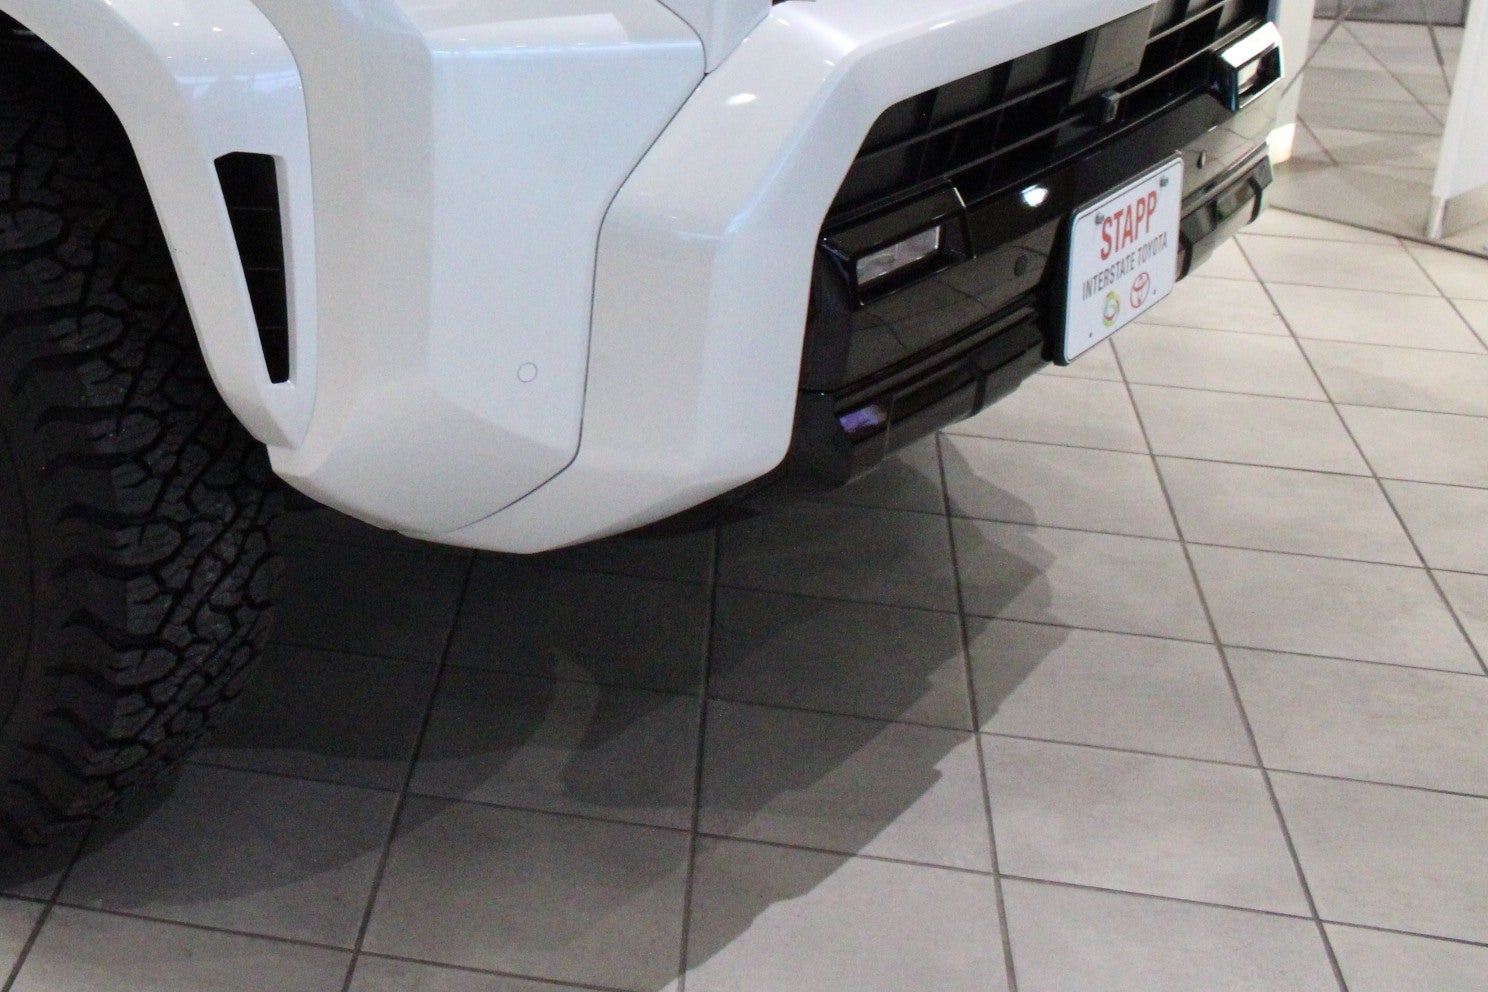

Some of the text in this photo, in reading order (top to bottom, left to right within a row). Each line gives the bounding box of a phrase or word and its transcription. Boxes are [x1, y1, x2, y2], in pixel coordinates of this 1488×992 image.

[1100, 191, 1157, 260] STAPP
[1083, 232, 1168, 300] INTERSTATE TOYOTA
